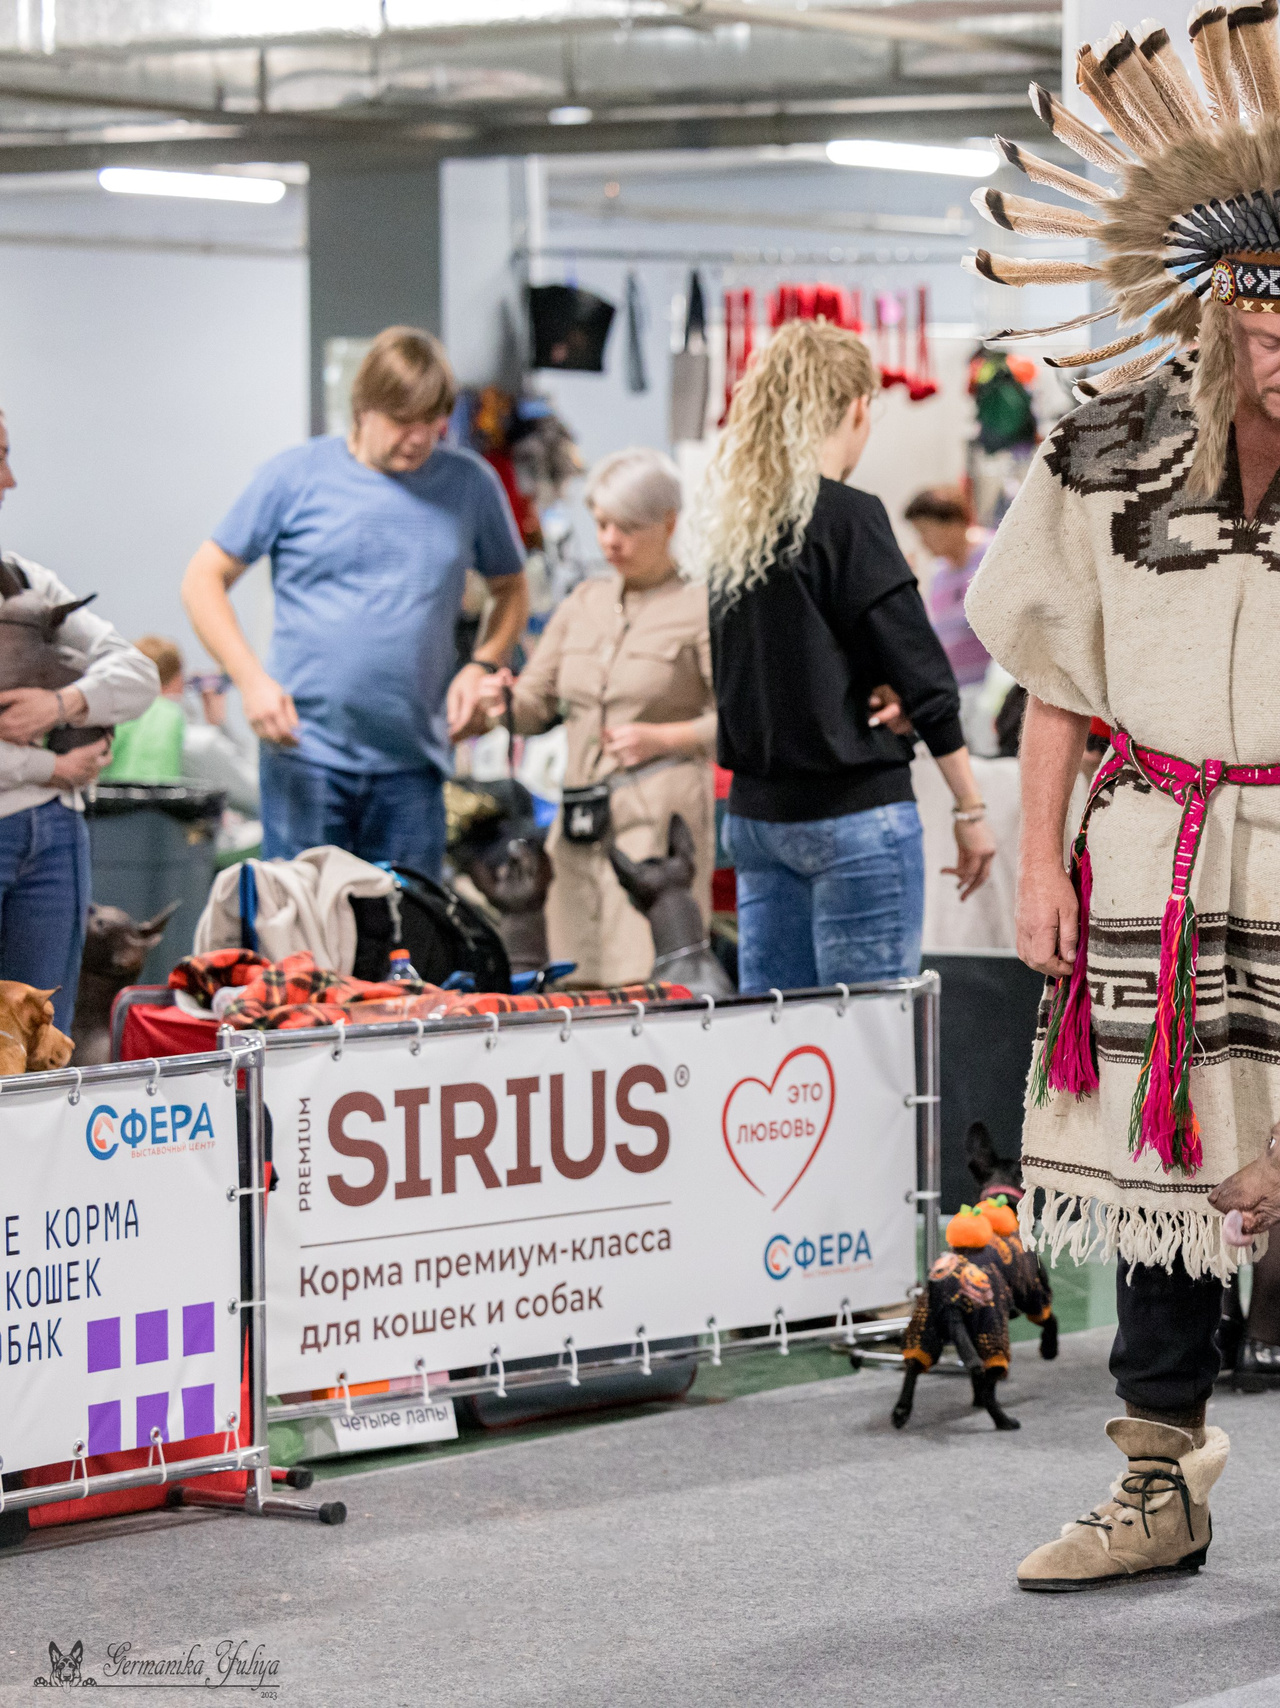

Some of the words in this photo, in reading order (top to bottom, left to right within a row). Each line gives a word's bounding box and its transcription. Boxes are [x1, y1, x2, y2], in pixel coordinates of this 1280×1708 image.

[788, 1083, 823, 1104] ЭТО
[86, 1102, 215, 1161] СФЕРА
[298, 1097, 312, 1212] PREMIUM
[736, 1118, 816, 1144] ЛЮБОВЬ
[45, 1199, 139, 1251] КОРМА
[300, 1264, 403, 1301] Корма
[415, 1226, 673, 1288] премиум-класса
[765, 1230, 872, 1280] СФЕРА
[6, 1257, 102, 1312] КОШЕК
[0, 1317, 63, 1366] БАК
[301, 1319, 361, 1355] для
[373, 1303, 477, 1341] кошек
[487, 1299, 505, 1325] и
[515, 1281, 604, 1320] собак
